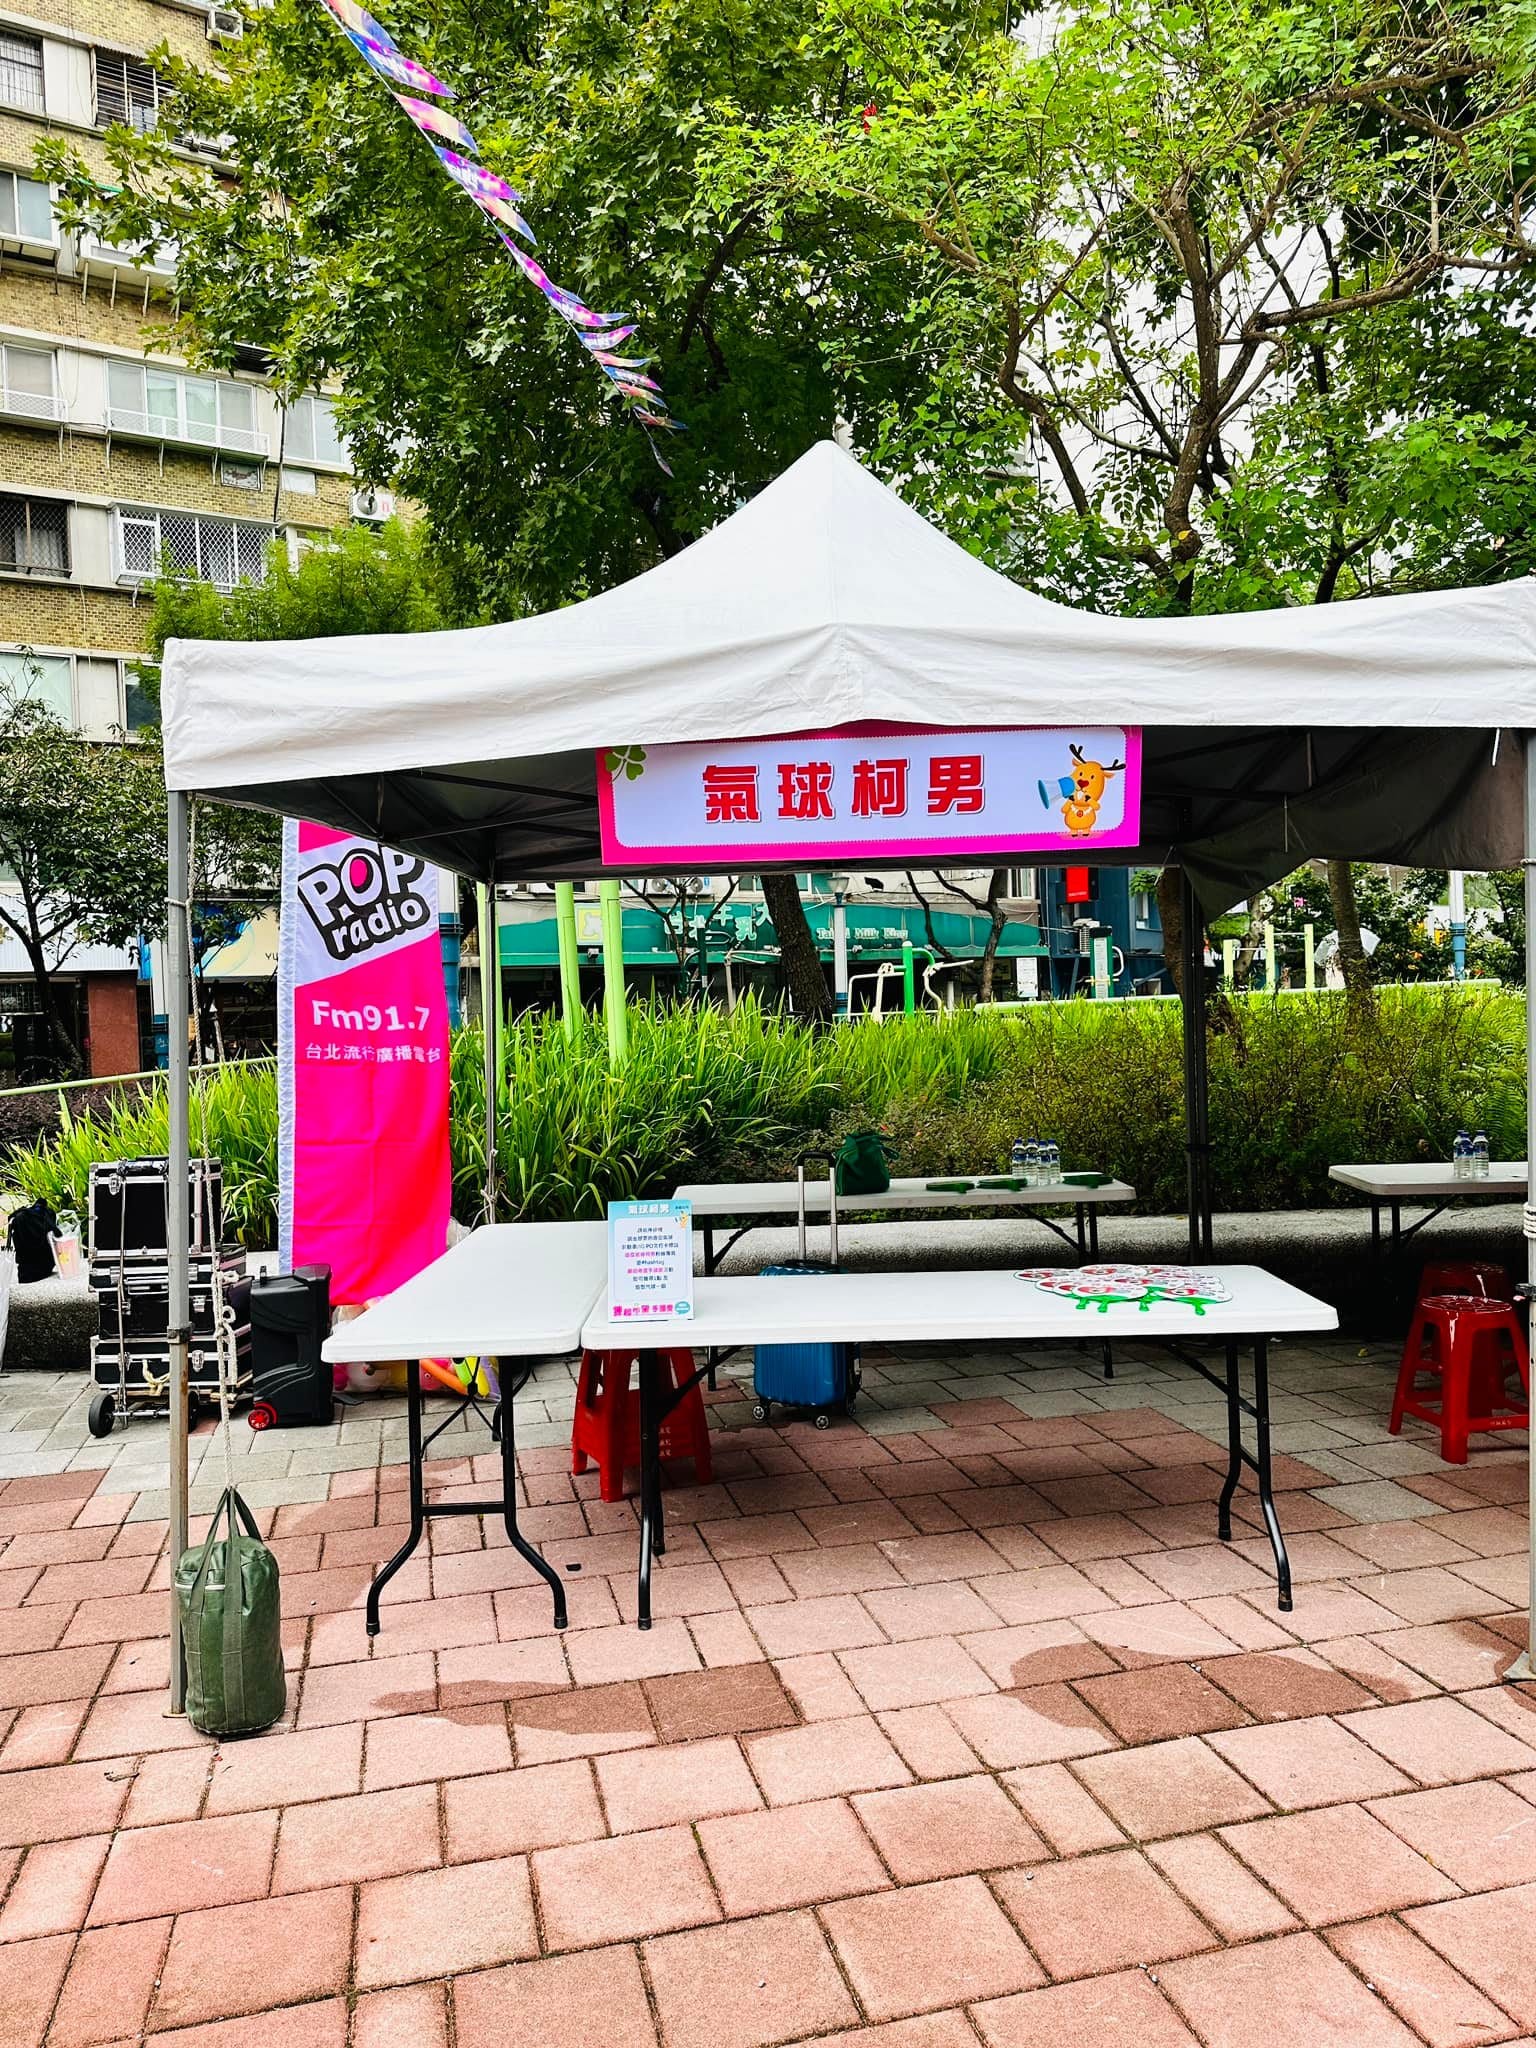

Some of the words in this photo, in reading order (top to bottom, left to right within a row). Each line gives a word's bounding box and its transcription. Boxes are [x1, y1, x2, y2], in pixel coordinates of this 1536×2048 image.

[702, 754, 985, 824] 氣球柯男
[299, 845, 421, 927] POP
[329, 897, 423, 953] radio
[816, 927, 851, 939] Taii
[311, 999, 430, 1031] Fm91.7
[304, 1042, 441, 1063] 台北流行廣播電台
